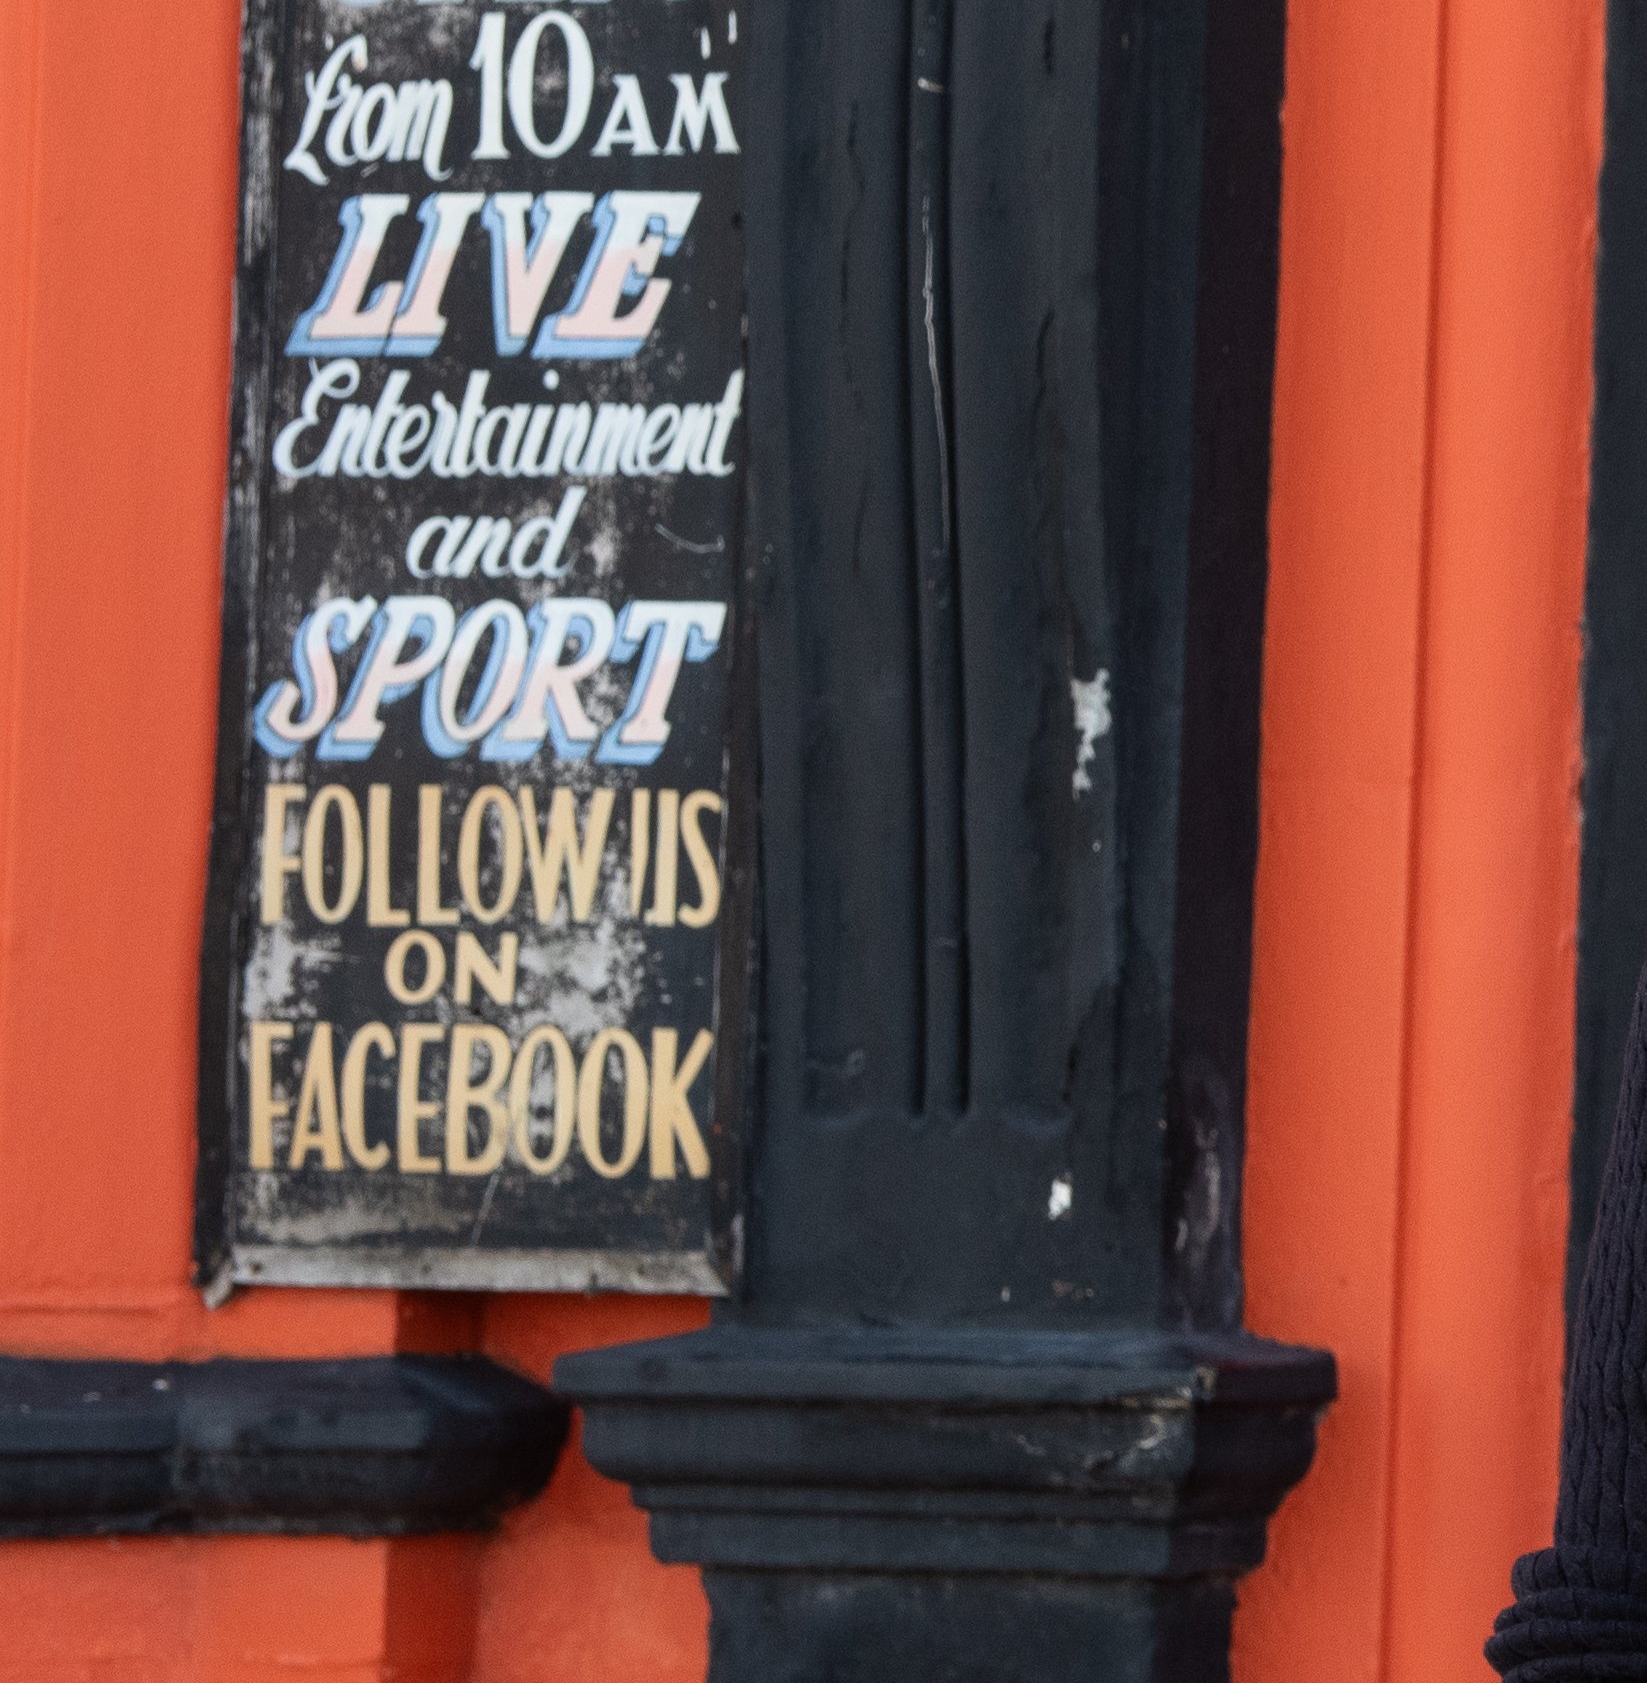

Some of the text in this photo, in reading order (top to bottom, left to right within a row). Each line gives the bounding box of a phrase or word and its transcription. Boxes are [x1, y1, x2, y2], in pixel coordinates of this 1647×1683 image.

[284, 34, 453, 186] from
[284, 191, 701, 359] LIVE
[272, 356, 745, 480] Entertainment
[406, 485, 587, 579] and
[253, 594, 726, 765] SPORT
[260, 783, 614, 927] FOLLOW
[384, 929, 518, 1006] ON
[248, 1021, 715, 1180] FACEBOOK
